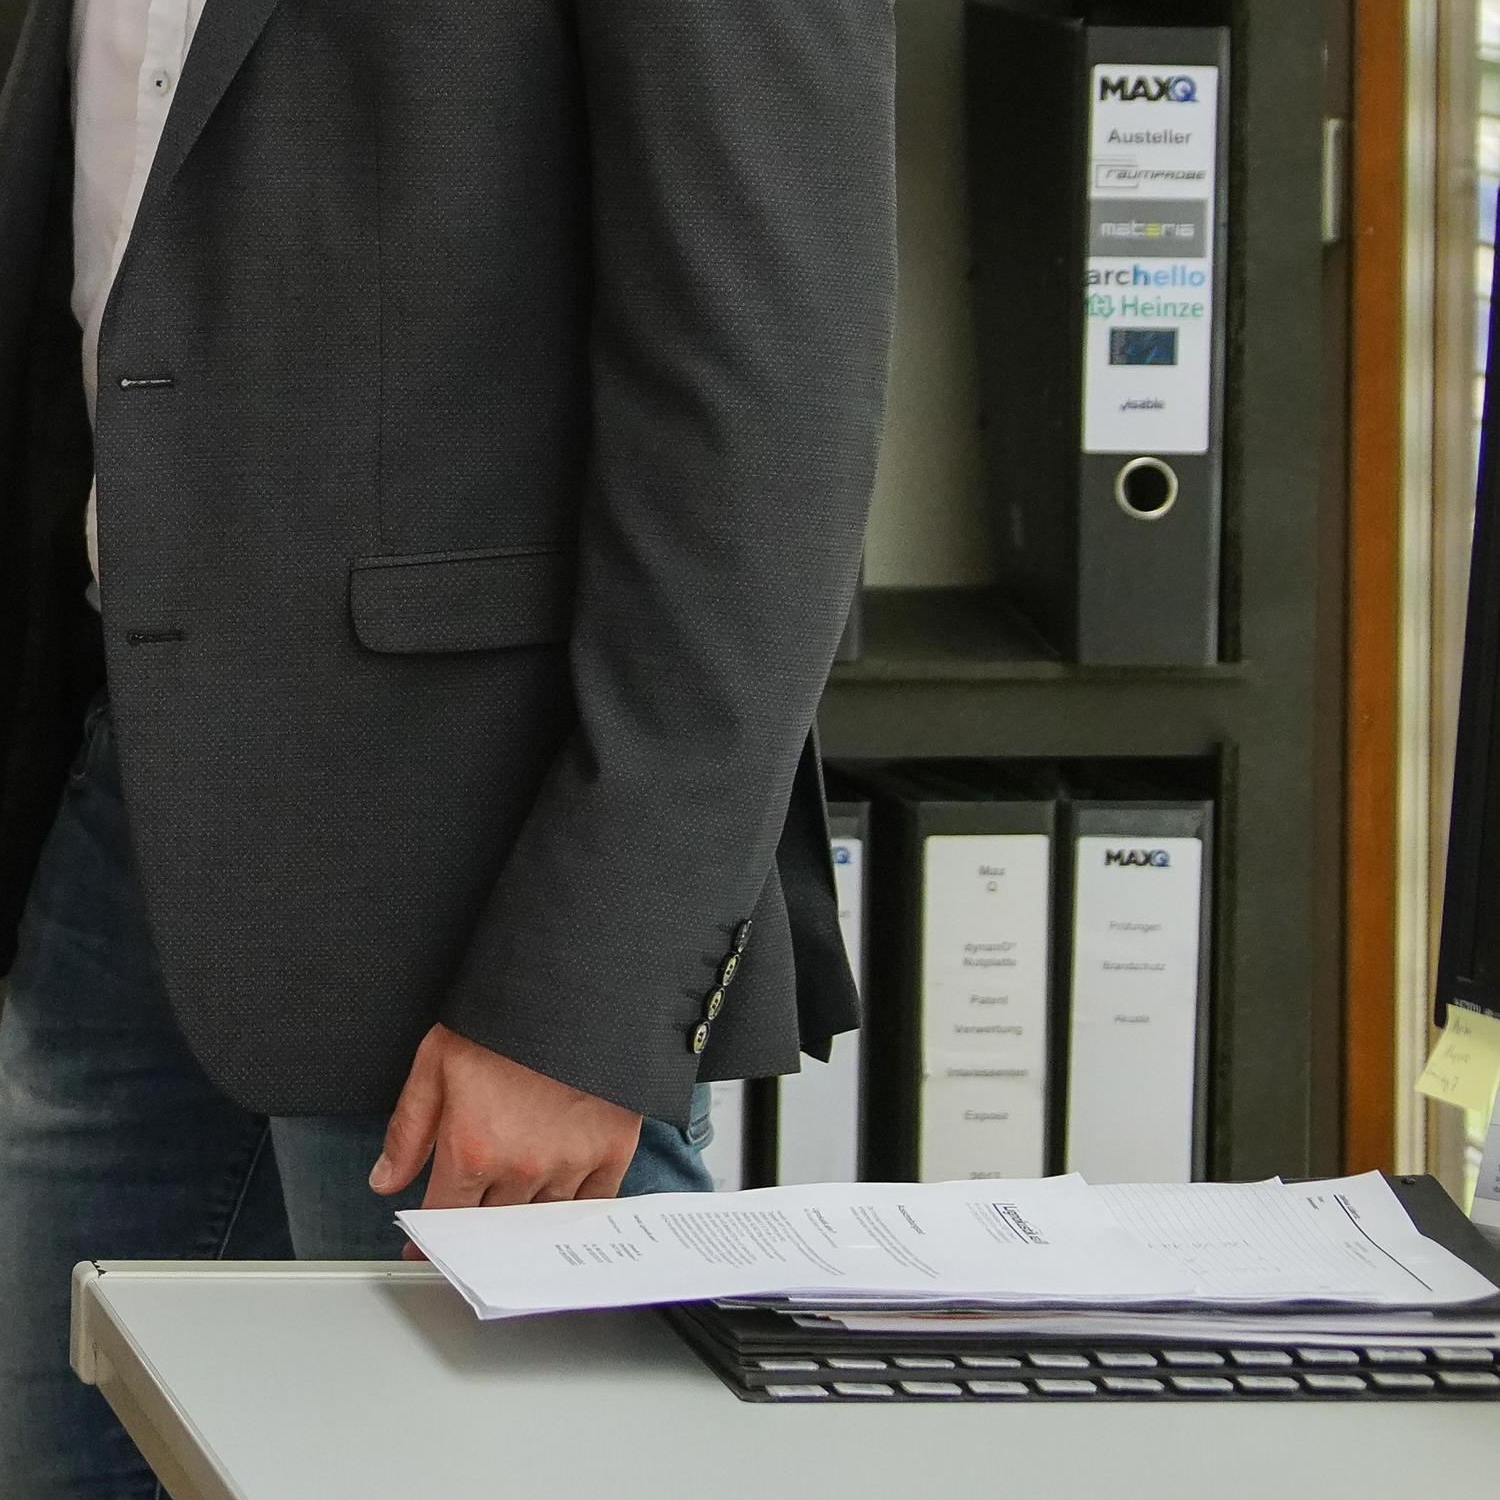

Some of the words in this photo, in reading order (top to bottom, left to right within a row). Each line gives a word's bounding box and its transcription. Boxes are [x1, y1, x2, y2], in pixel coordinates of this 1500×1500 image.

[1100, 75, 1199, 102] MAXQ
[1107, 127, 1192, 144] Austeller
[1087, 264, 1206, 287] archello
[1121, 295, 1204, 318] Heinze
[1105, 849, 1170, 868] MAXQ
